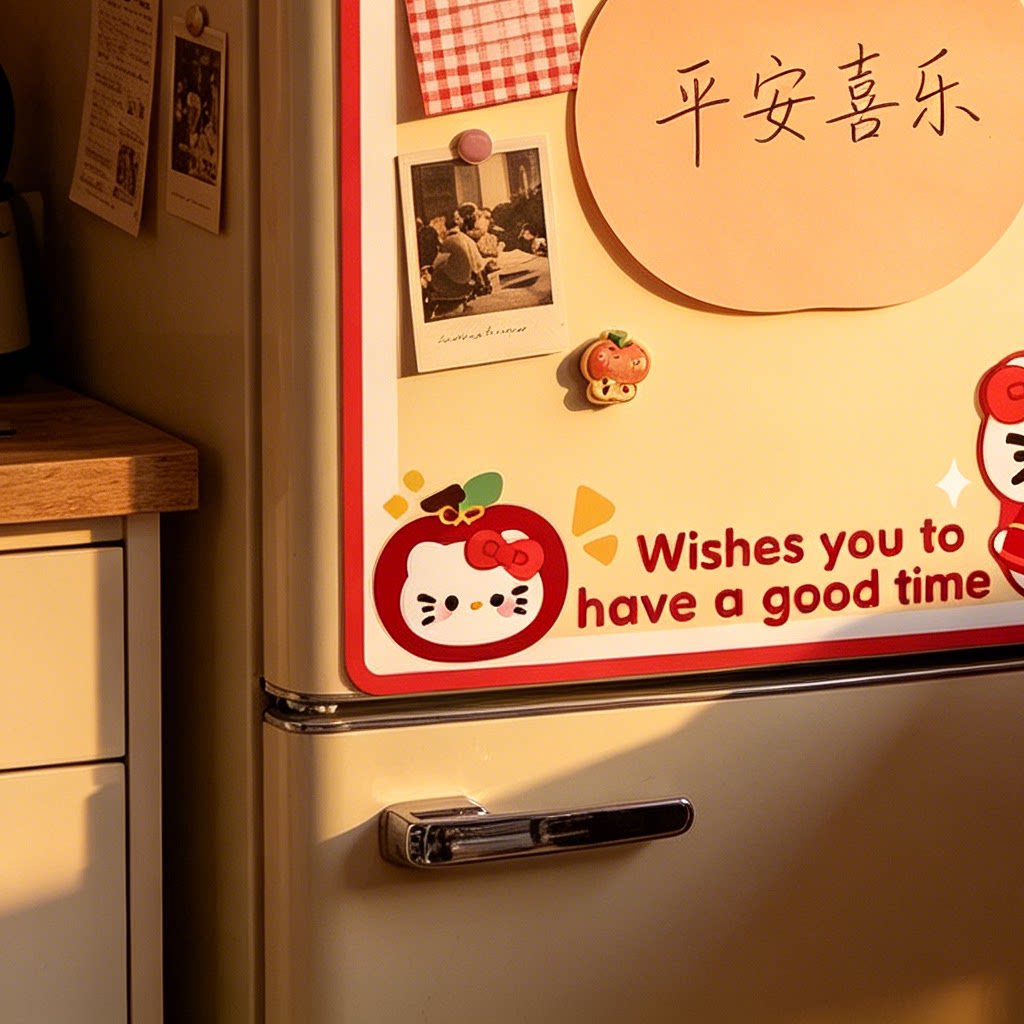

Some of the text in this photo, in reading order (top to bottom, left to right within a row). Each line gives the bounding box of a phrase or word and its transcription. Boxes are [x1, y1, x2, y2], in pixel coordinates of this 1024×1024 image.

[655, 42, 981, 168] 平安喜乐
[636, 518, 965, 574] Wishes you to
[577, 565, 991, 629] have a good time
